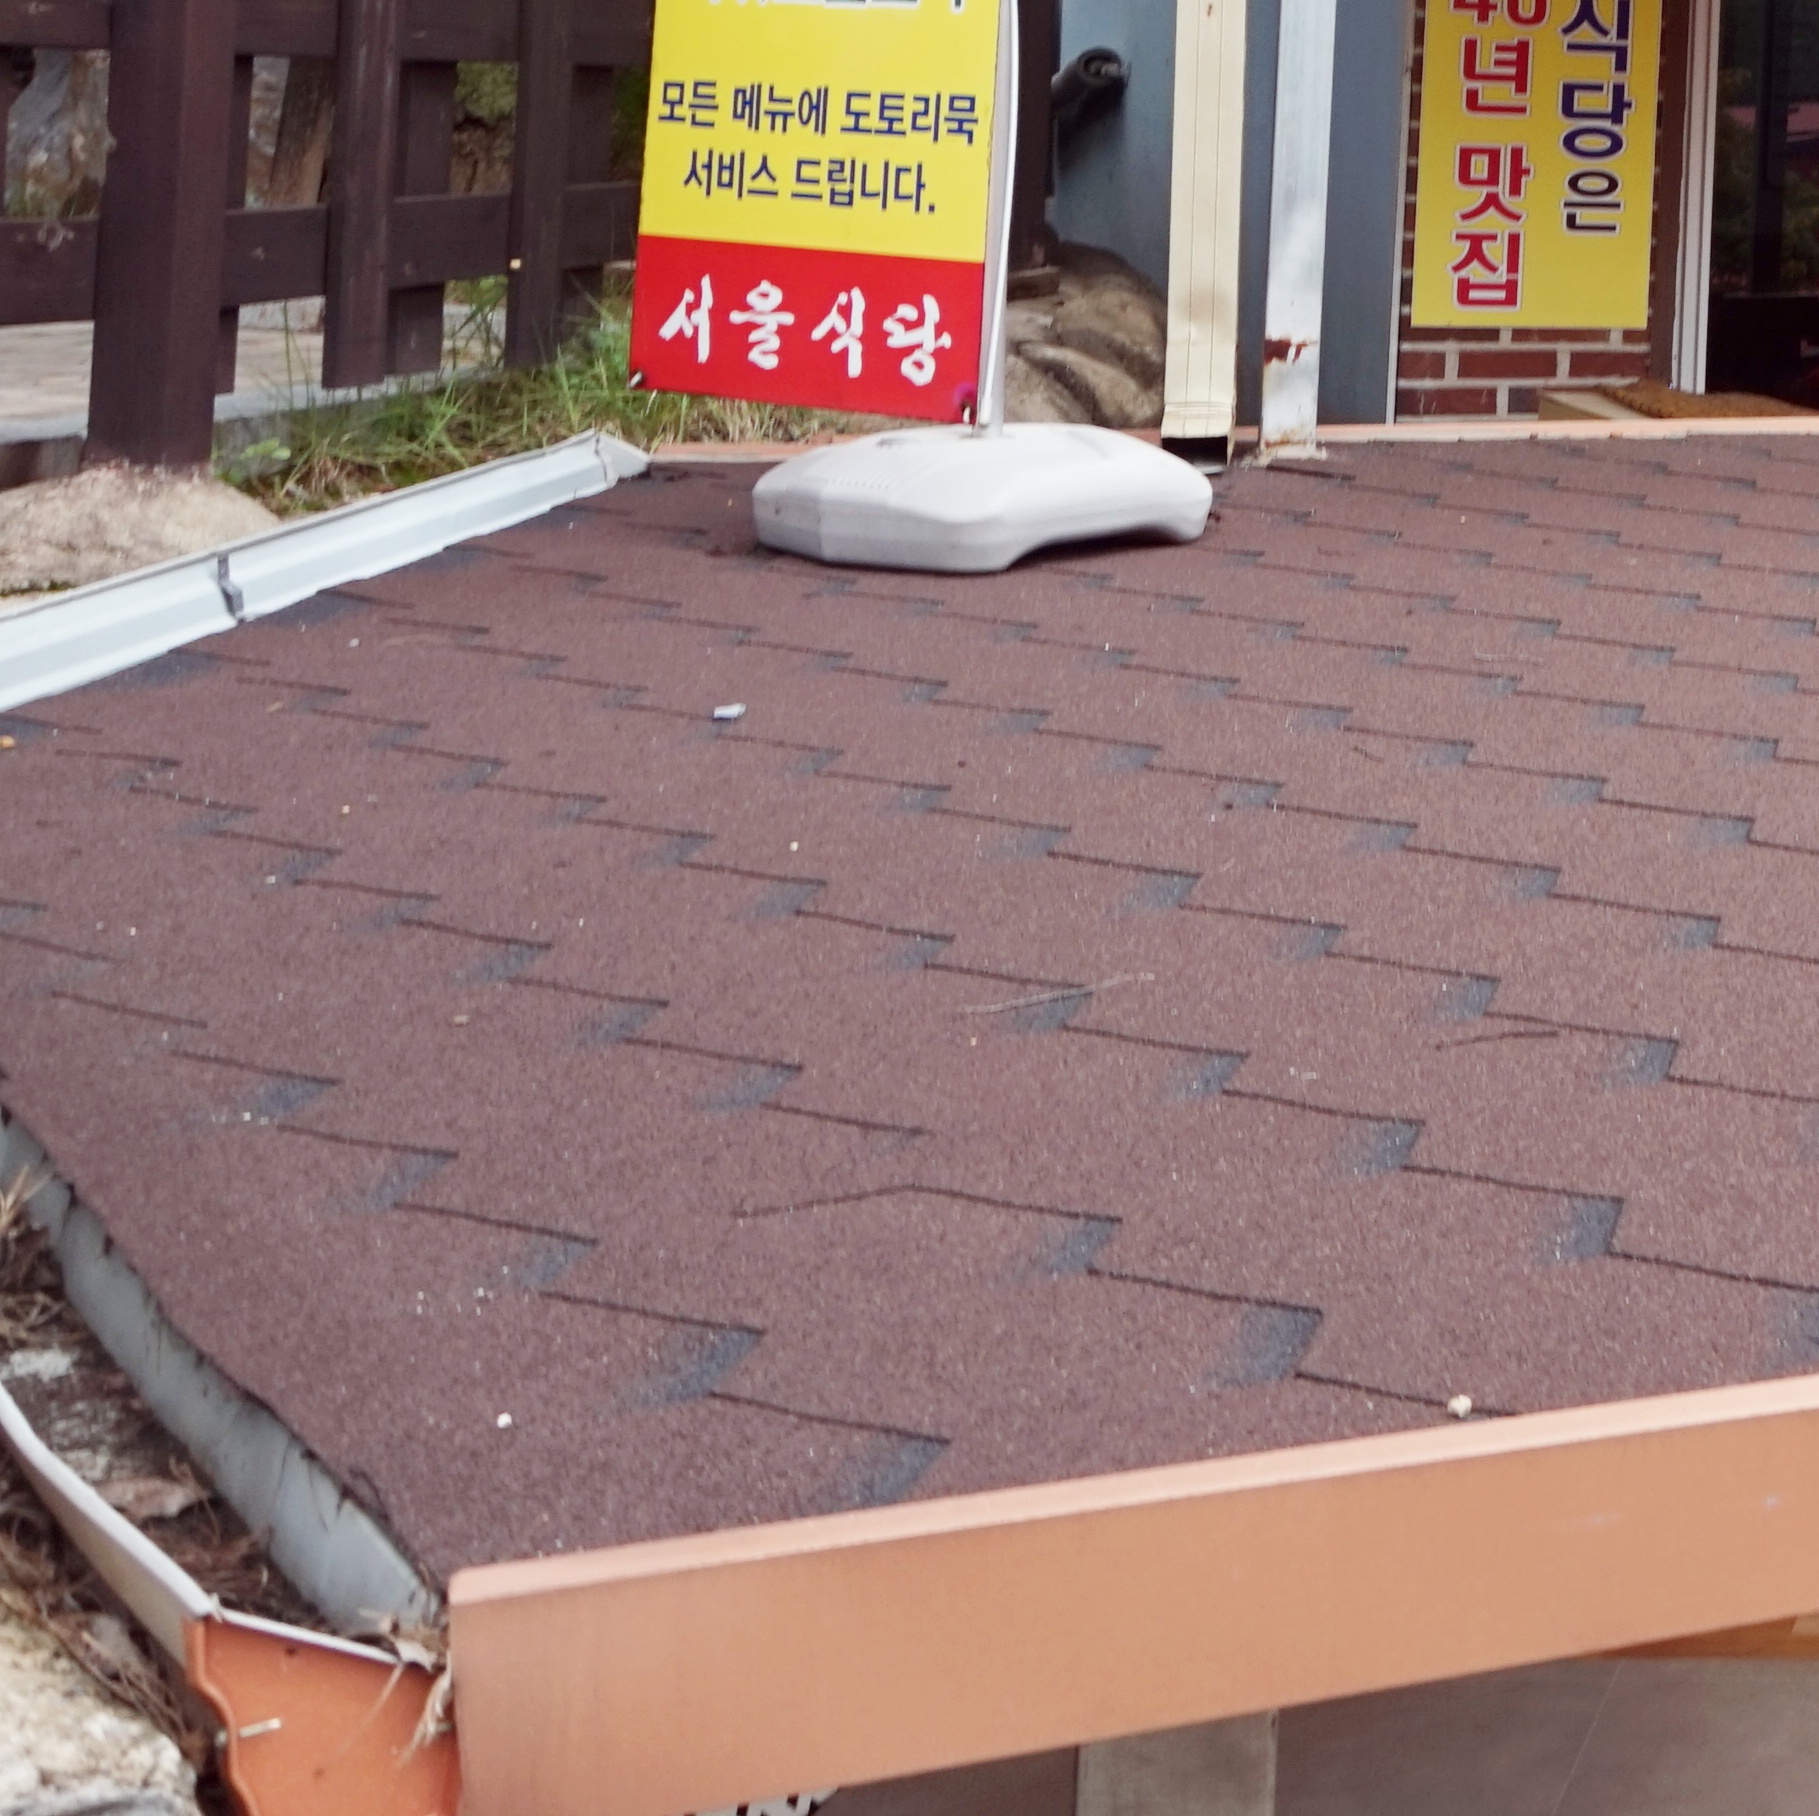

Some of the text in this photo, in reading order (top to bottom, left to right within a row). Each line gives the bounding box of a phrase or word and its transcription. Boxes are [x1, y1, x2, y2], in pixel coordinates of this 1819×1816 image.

[656, 80, 980, 146] 모든 메뉴에 도토리묵
[683, 148, 937, 214] 서비스 드립니다.
[1449, 142, 1534, 312] 맛집
[657, 274, 952, 387] 서울식당
